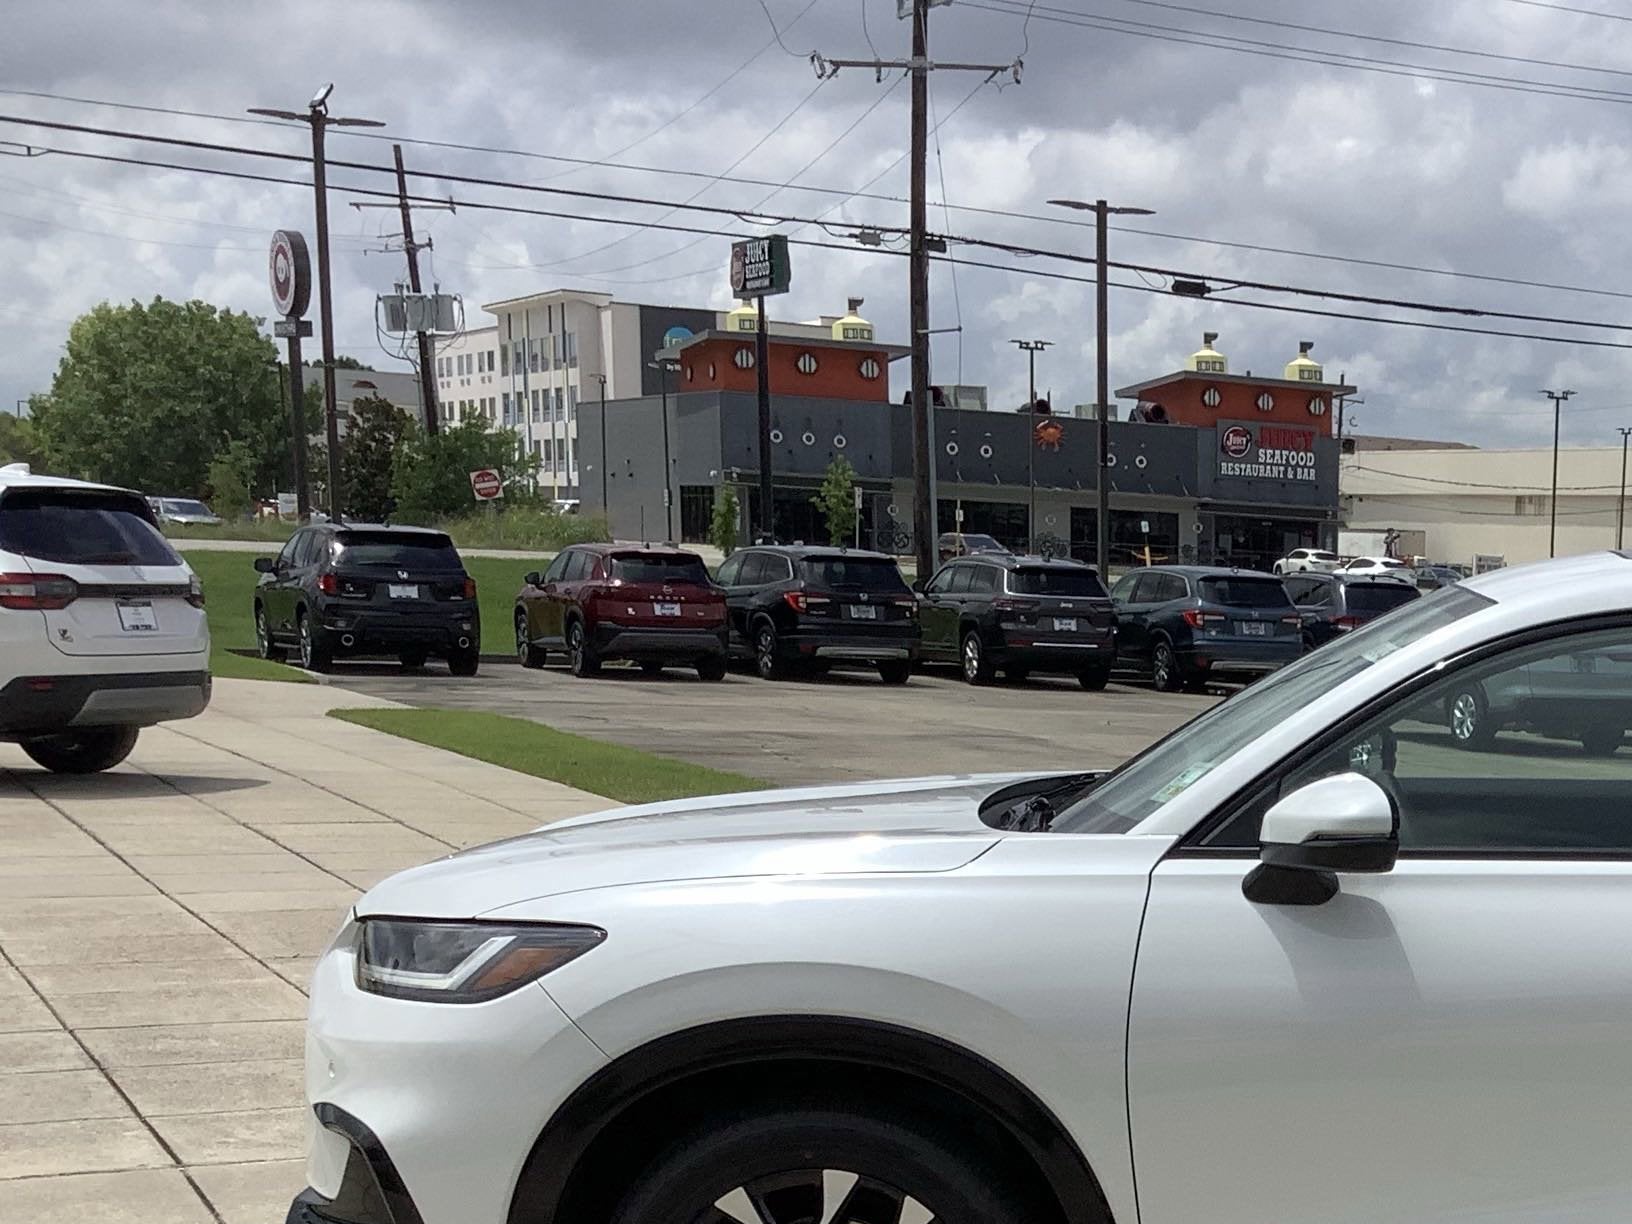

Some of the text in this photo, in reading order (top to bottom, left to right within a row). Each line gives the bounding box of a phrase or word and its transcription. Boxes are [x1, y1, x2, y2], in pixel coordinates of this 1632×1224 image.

[1258, 448, 1316, 467] SEAFOOD
[1221, 462, 1316, 480] RESTAURANT & BAR
